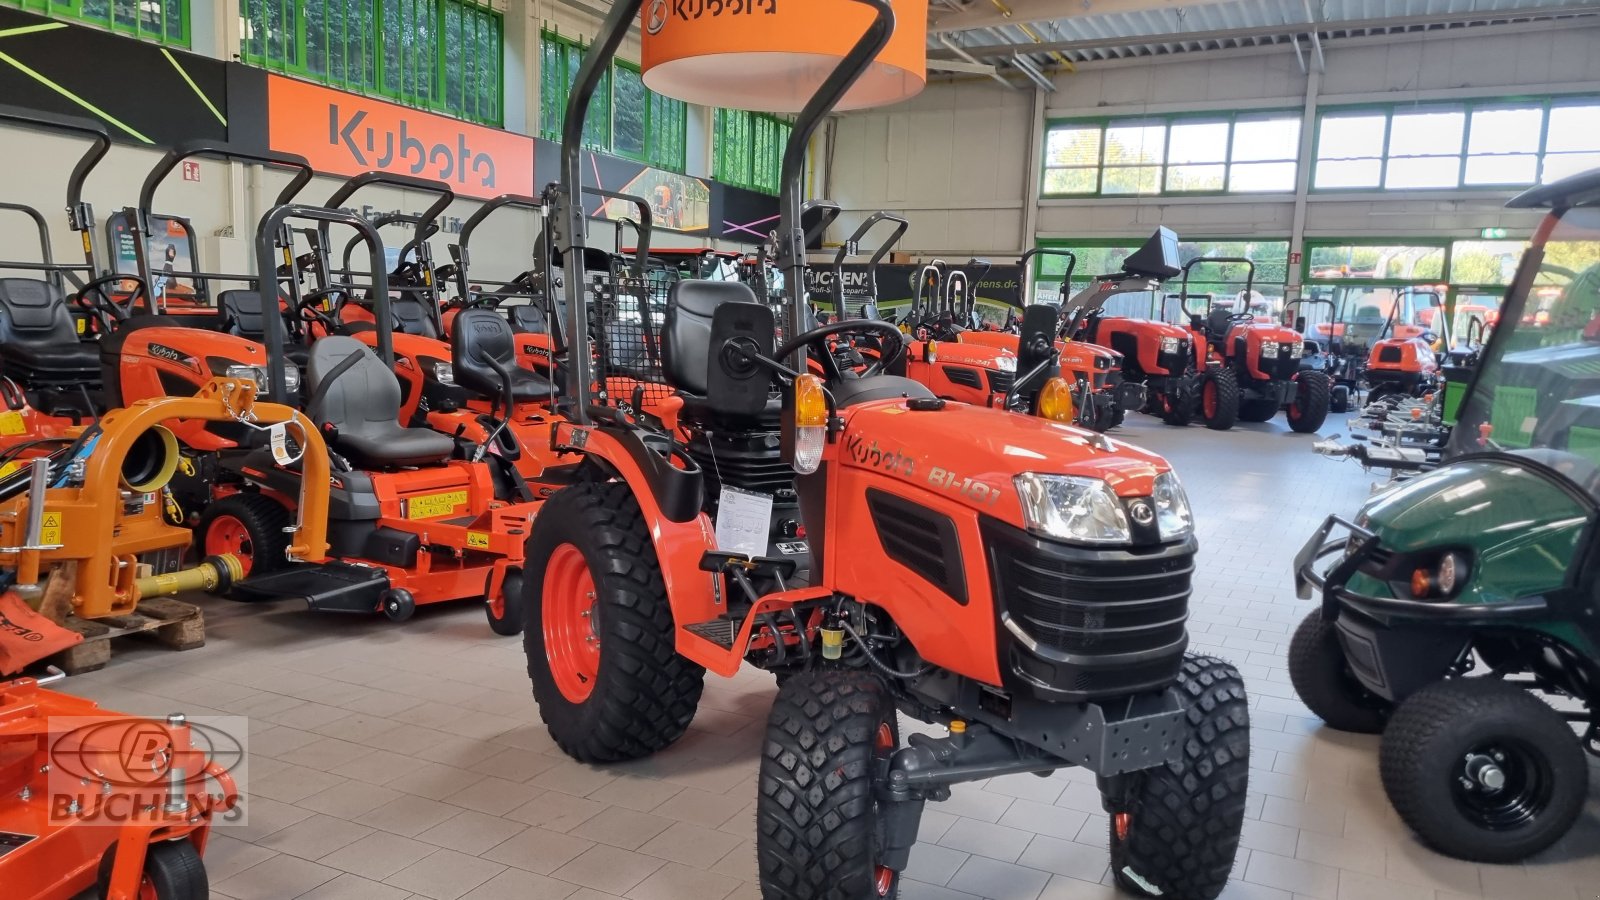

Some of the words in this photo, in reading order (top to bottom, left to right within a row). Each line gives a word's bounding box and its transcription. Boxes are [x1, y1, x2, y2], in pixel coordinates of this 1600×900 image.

[329, 103, 495, 188] Kubota
[151, 344, 178, 361] Kubota
[846, 435, 914, 477] Kubota
[927, 466, 1001, 506] B1-181
